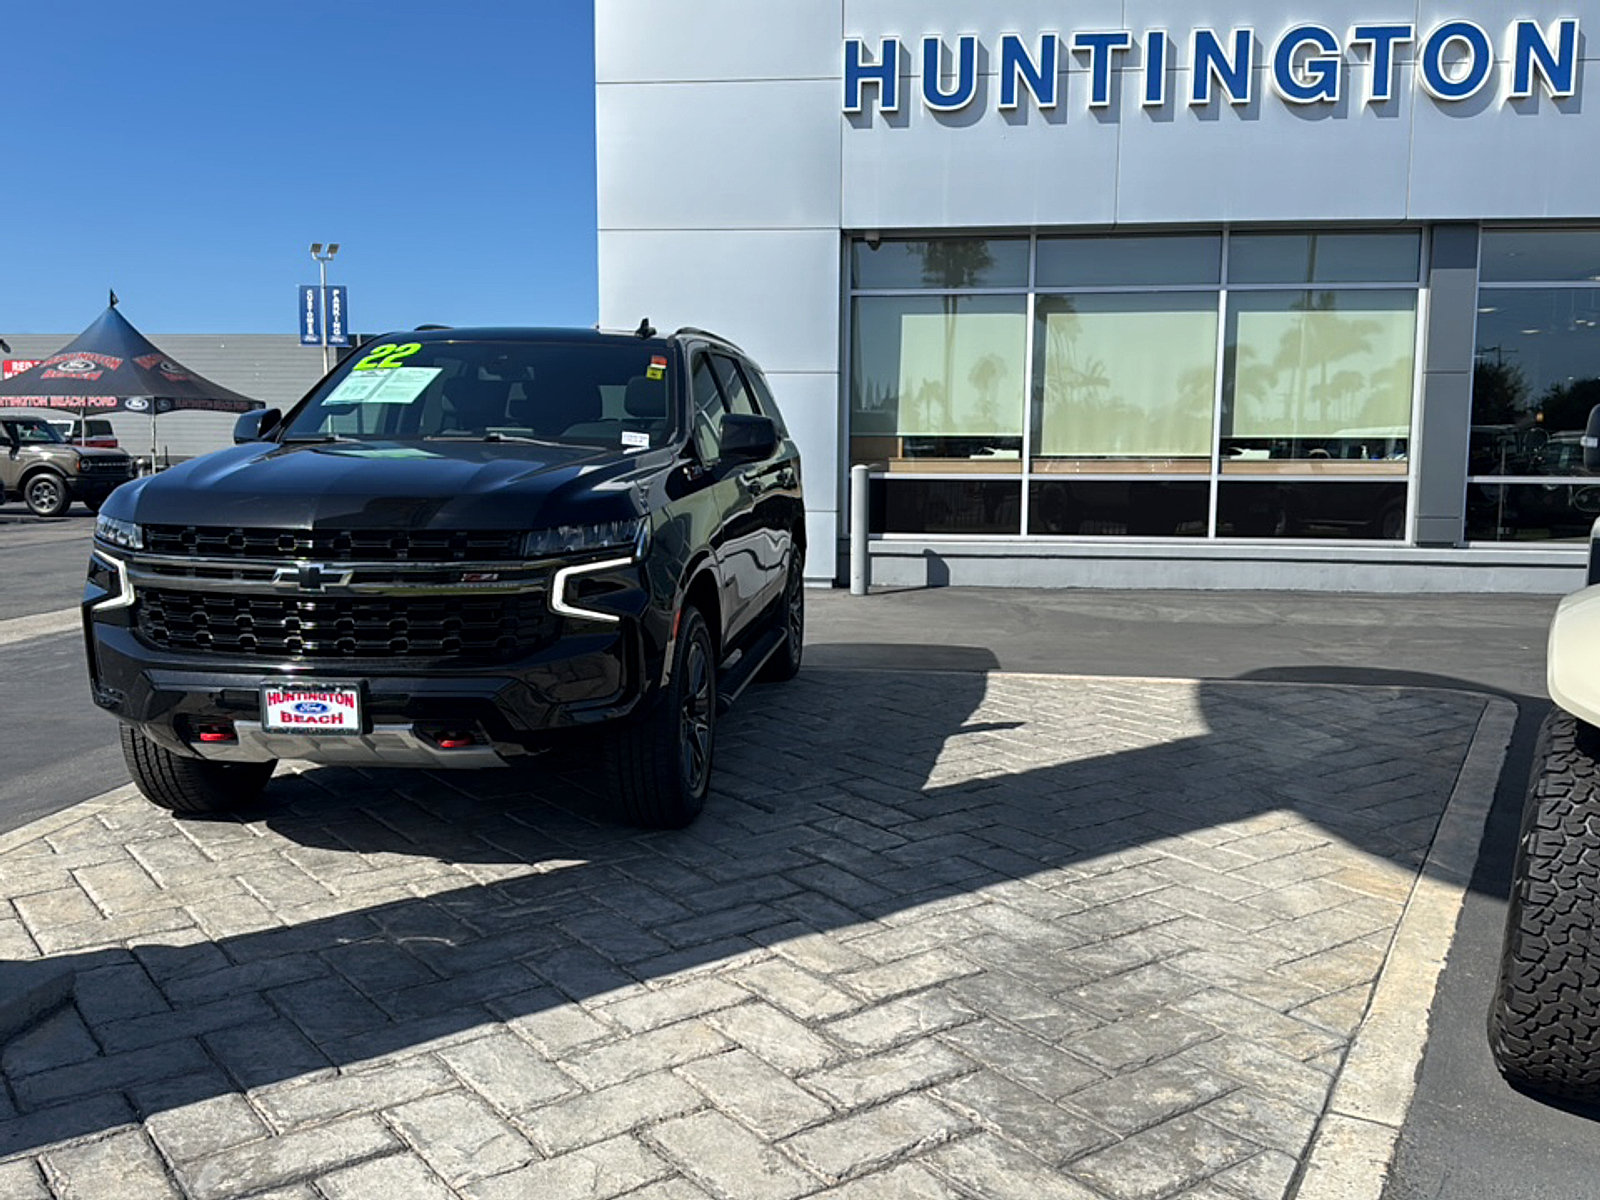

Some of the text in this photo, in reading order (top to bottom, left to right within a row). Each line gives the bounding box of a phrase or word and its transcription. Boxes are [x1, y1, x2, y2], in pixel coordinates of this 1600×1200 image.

[842, 18, 1581, 114] HUNTINGTON
[332, 289, 341, 335] PARKING
[353, 343, 421, 370] 22
[50, 396, 86, 408] BEACH
[87, 397, 118, 408] FORD
[267, 691, 354, 708] HUNTINGTON
[280, 710, 344, 724] BEACH
